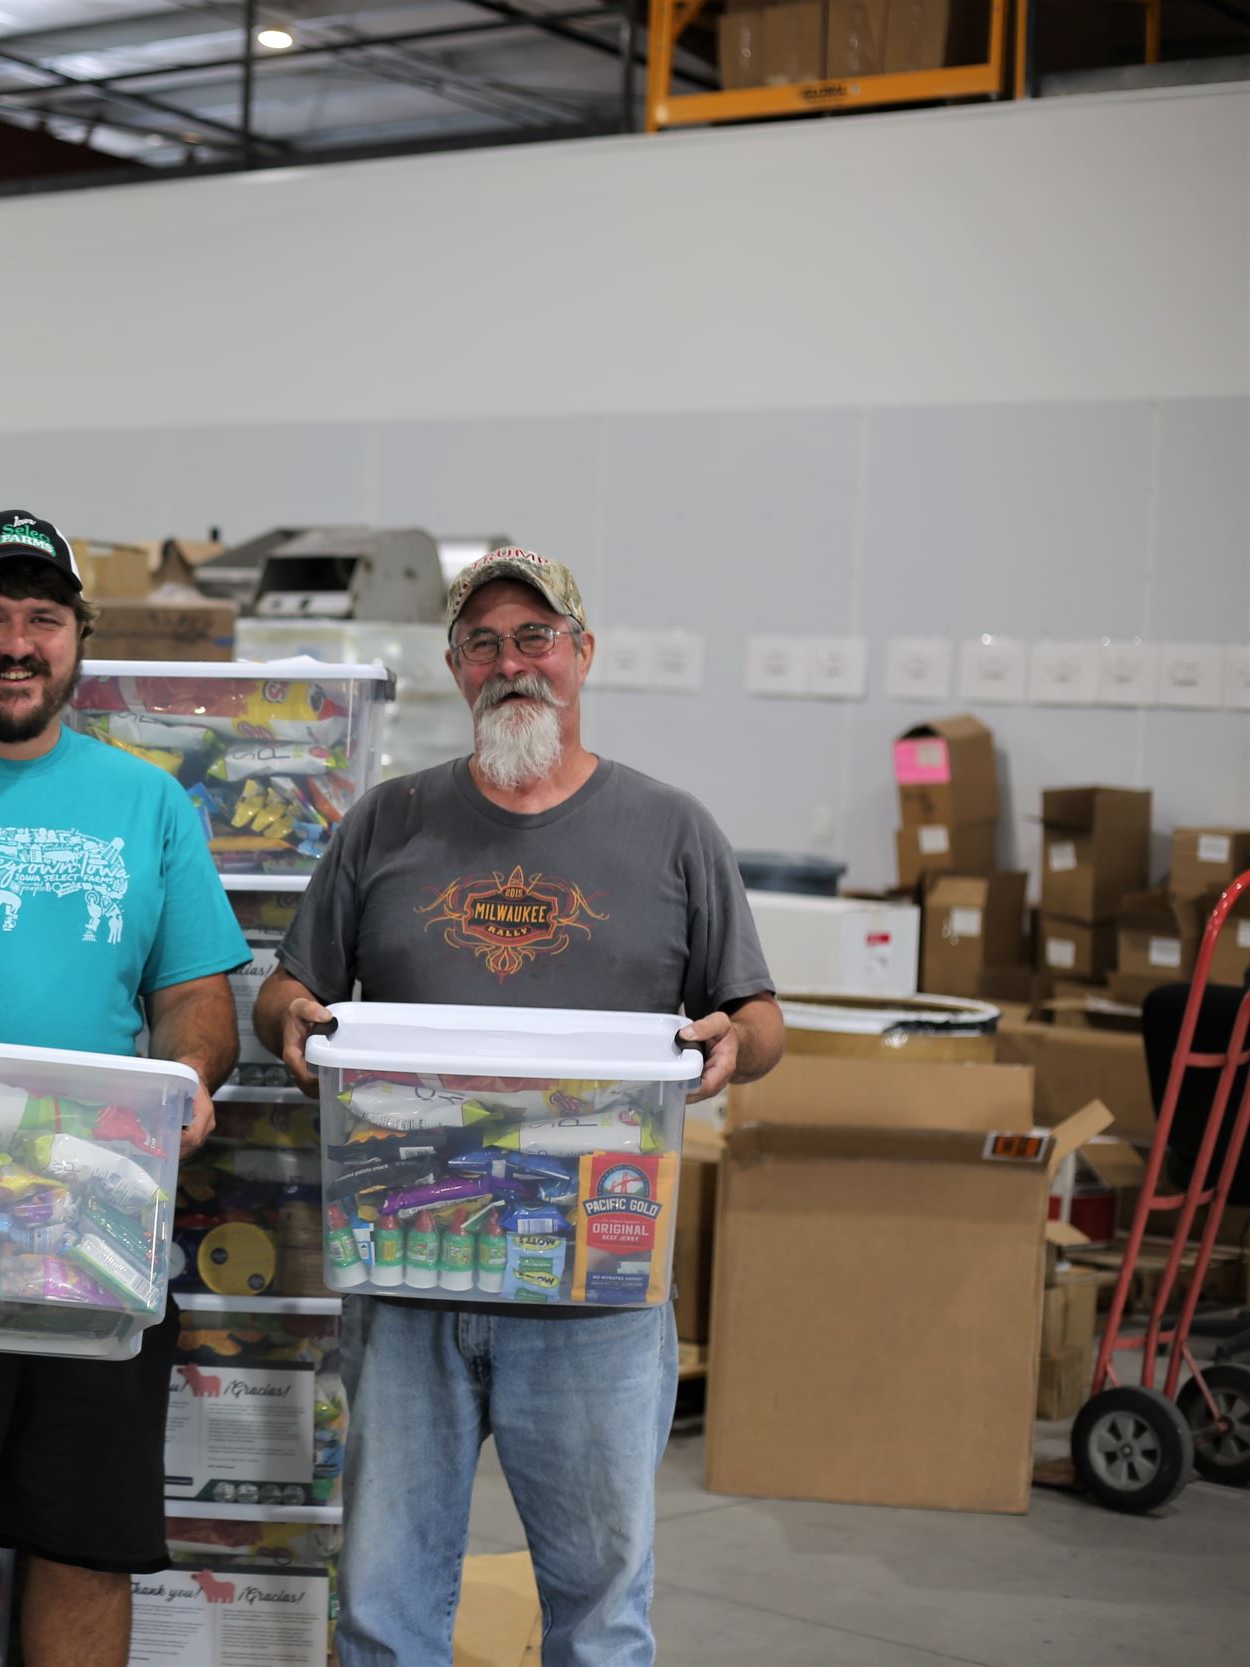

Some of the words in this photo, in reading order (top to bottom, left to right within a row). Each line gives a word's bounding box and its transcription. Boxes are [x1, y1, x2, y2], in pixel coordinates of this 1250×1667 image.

[13, 516, 37, 528] Iowa
[1, 534, 54, 553] FARMS
[79, 850, 130, 880] Iowa
[15, 873, 41, 881] IOWA
[43, 873, 80, 882] SELECT
[504, 887, 524, 899] 2015
[474, 902, 548, 923] MILWAUKEE
[487, 925, 528, 937] RALLY
[584, 1197, 627, 1215] PACIFIC
[630, 1199, 659, 1217] GOLD
[592, 1223, 649, 1237] ORIGINAL
[168, 1585, 204, 1603] you!
